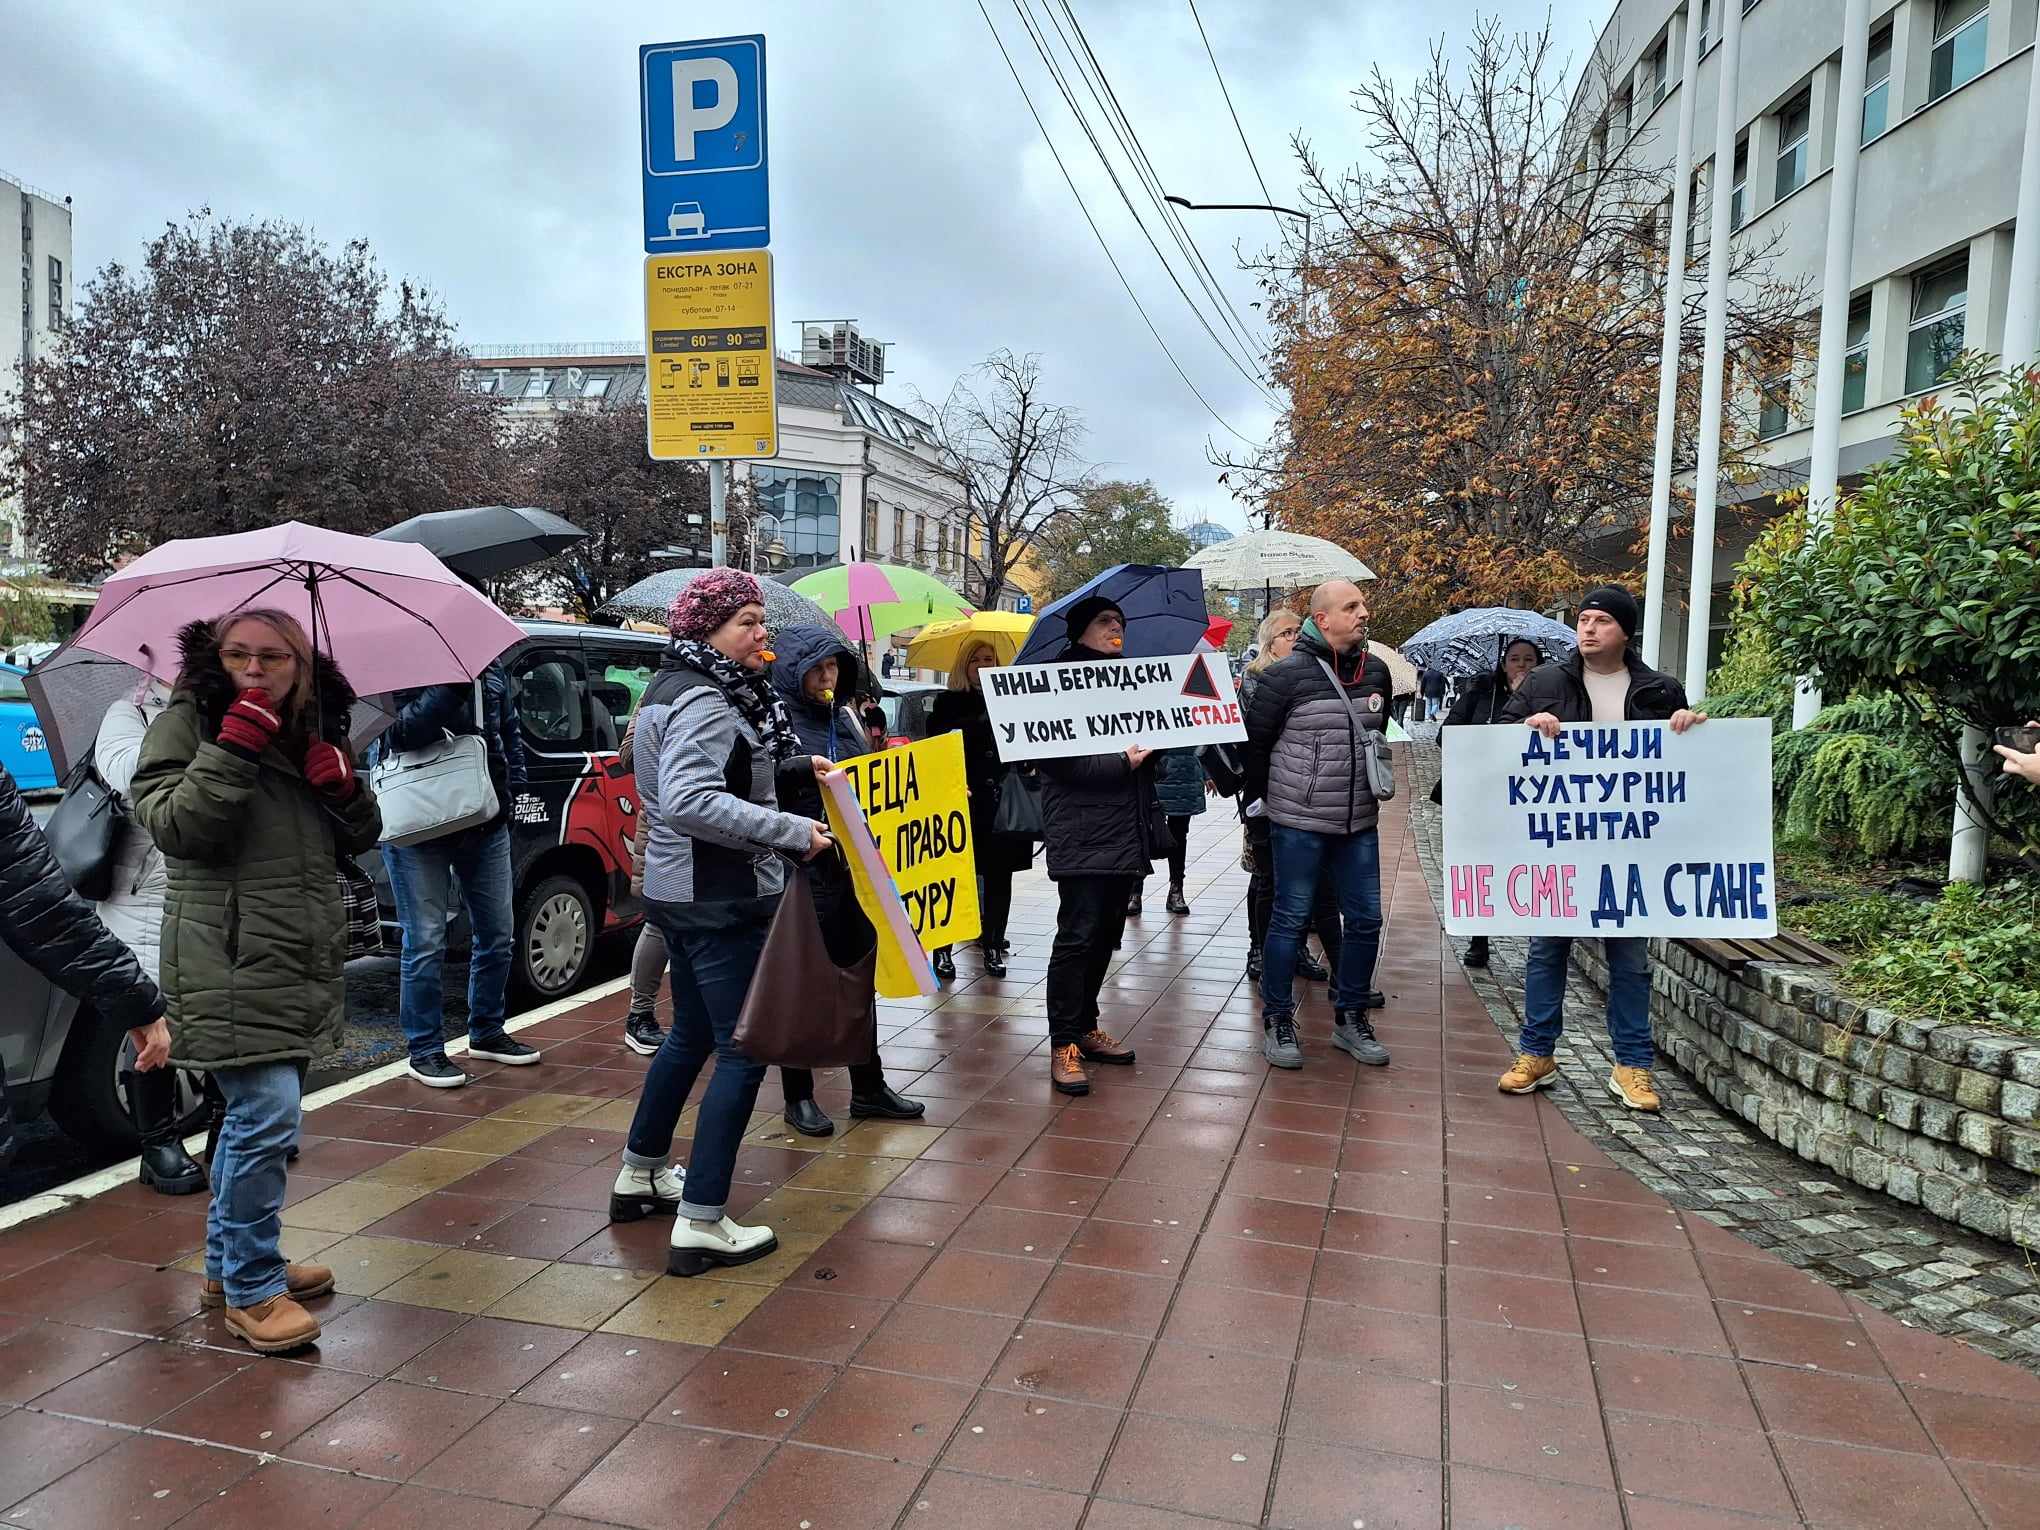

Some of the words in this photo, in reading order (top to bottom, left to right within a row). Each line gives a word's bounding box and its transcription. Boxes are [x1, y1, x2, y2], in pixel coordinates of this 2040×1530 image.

[672, 57, 738, 161] P
[657, 264, 712, 279] ЕКСТРА
[716, 262, 757, 276] ЗОНА
[691, 335, 707, 347] 60
[726, 333, 742, 346] 90
[1019, 598, 1028, 610] P
[1000, 722, 1015, 743] У
[1023, 718, 1077, 743] КОМЕ
[1086, 709, 1170, 737] КУЛТУРА
[1172, 703, 1241, 729] НЕСТАЈЕ
[1521, 727, 1662, 767] ДЕЧИЈИ
[1508, 771, 1686, 805] КУЛТУРНИ
[515, 802, 546, 815] OWER
[522, 811, 550, 824] HELL
[896, 810, 967, 873] ПРАВО
[1527, 810, 1660, 848] ЦЕНТАР
[1450, 864, 1494, 918] НЕ
[1506, 864, 1578, 918] СМЕ
[1590, 863, 1649, 928] ДА
[1663, 862, 1768, 919] СТАНЕ
